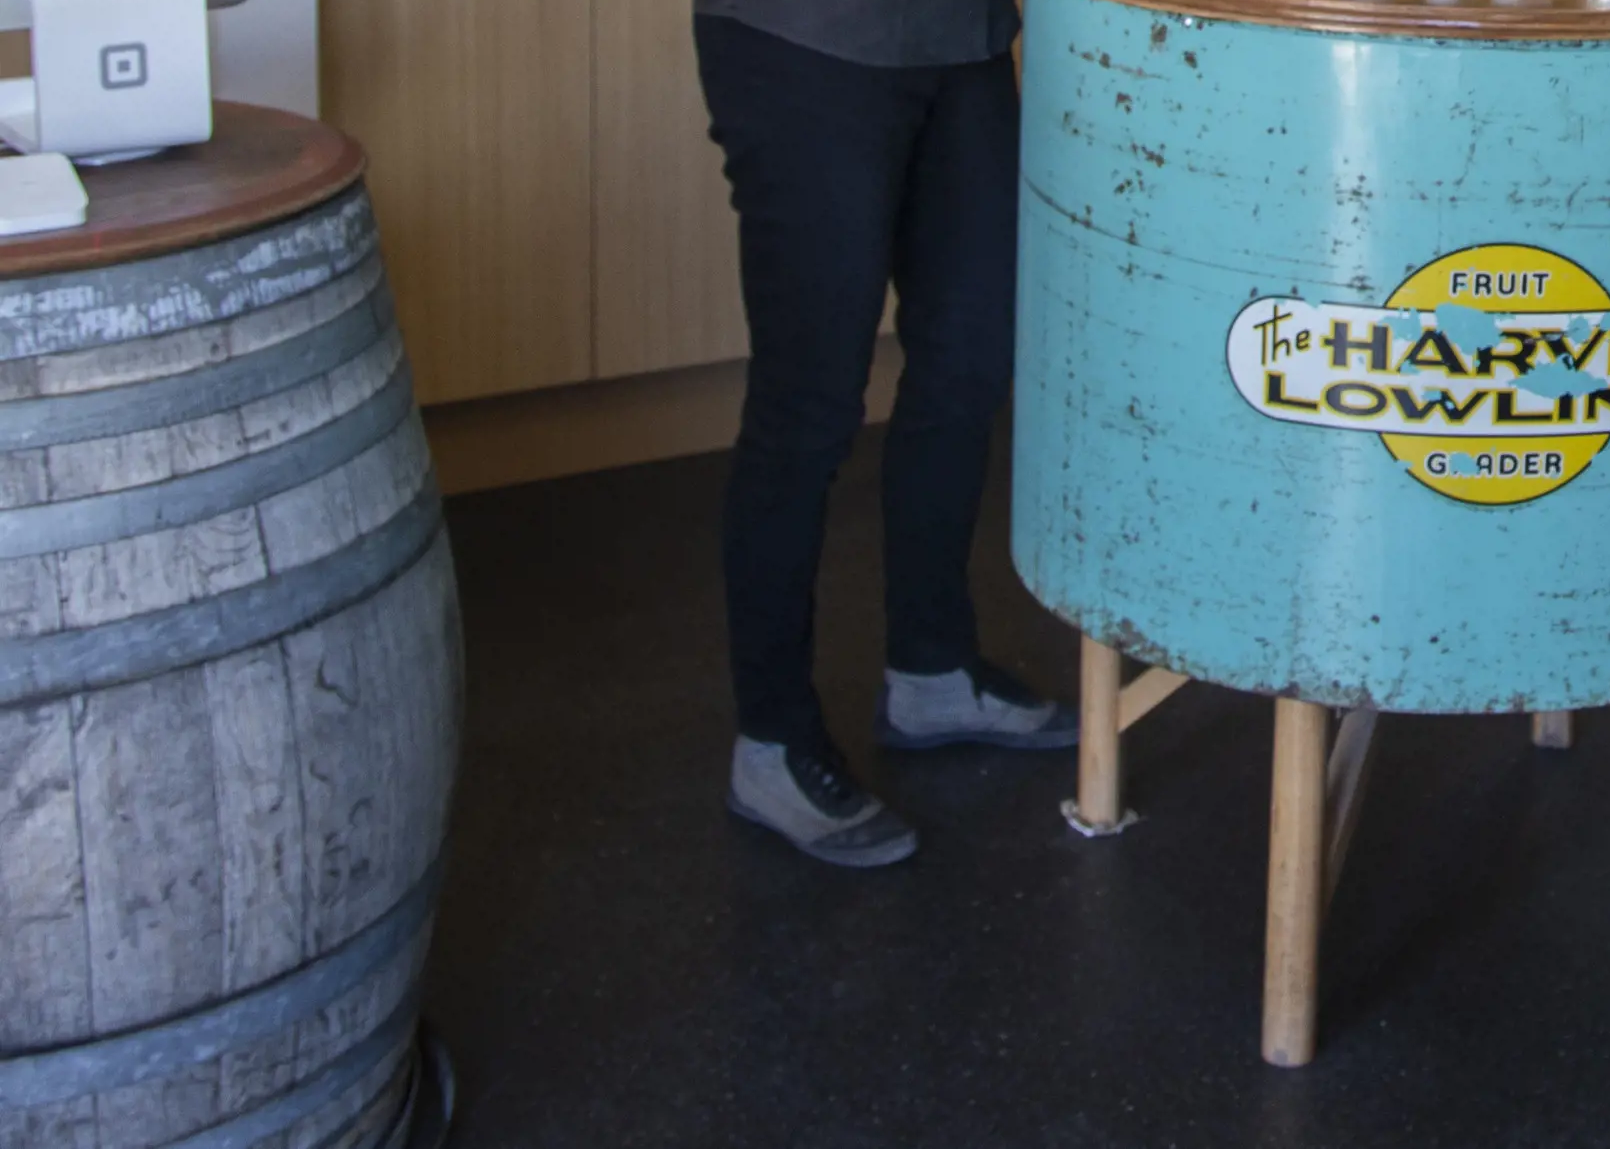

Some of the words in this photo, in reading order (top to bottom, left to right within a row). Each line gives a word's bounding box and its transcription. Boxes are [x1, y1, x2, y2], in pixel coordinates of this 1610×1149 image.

[1451, 271, 1551, 297] FRUIT
[1252, 304, 1311, 367] The
[1425, 451, 1564, 477] GADER
